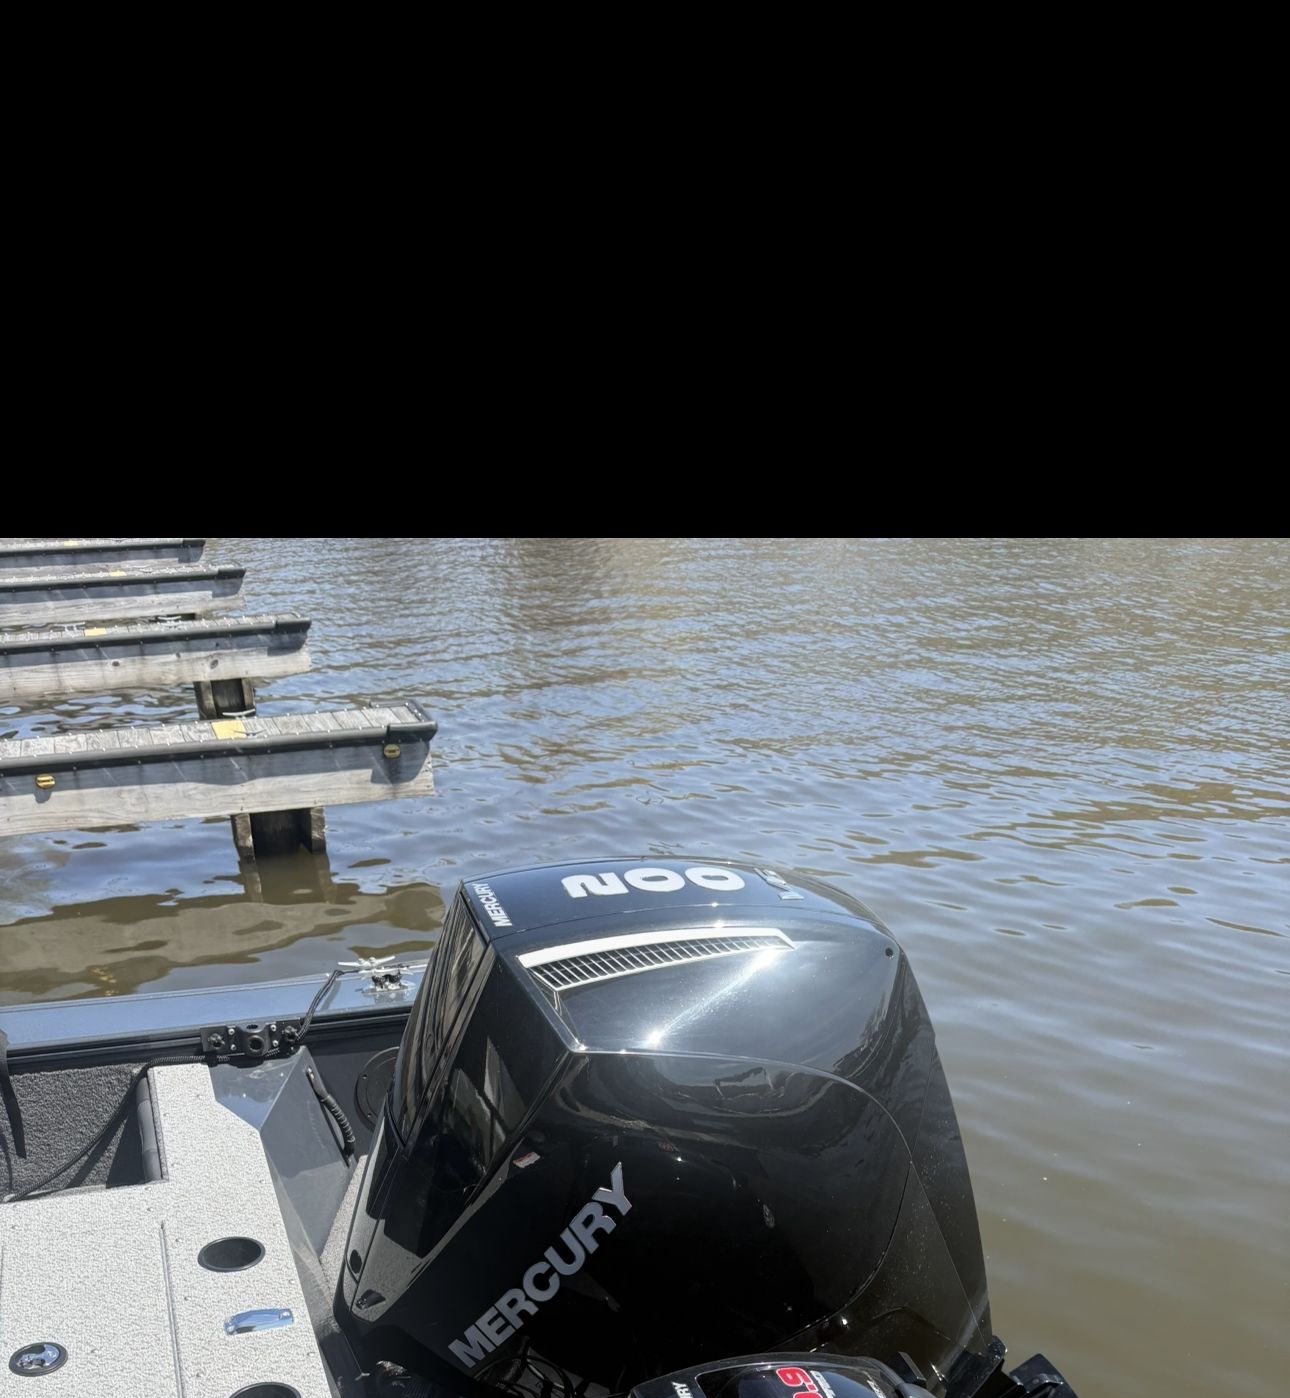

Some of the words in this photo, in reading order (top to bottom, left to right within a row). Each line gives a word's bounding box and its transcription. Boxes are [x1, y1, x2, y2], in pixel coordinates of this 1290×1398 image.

[472, 882, 513, 927] MERCURY
[560, 867, 746, 898] 200
[448, 1161, 632, 1368] MERCURY
